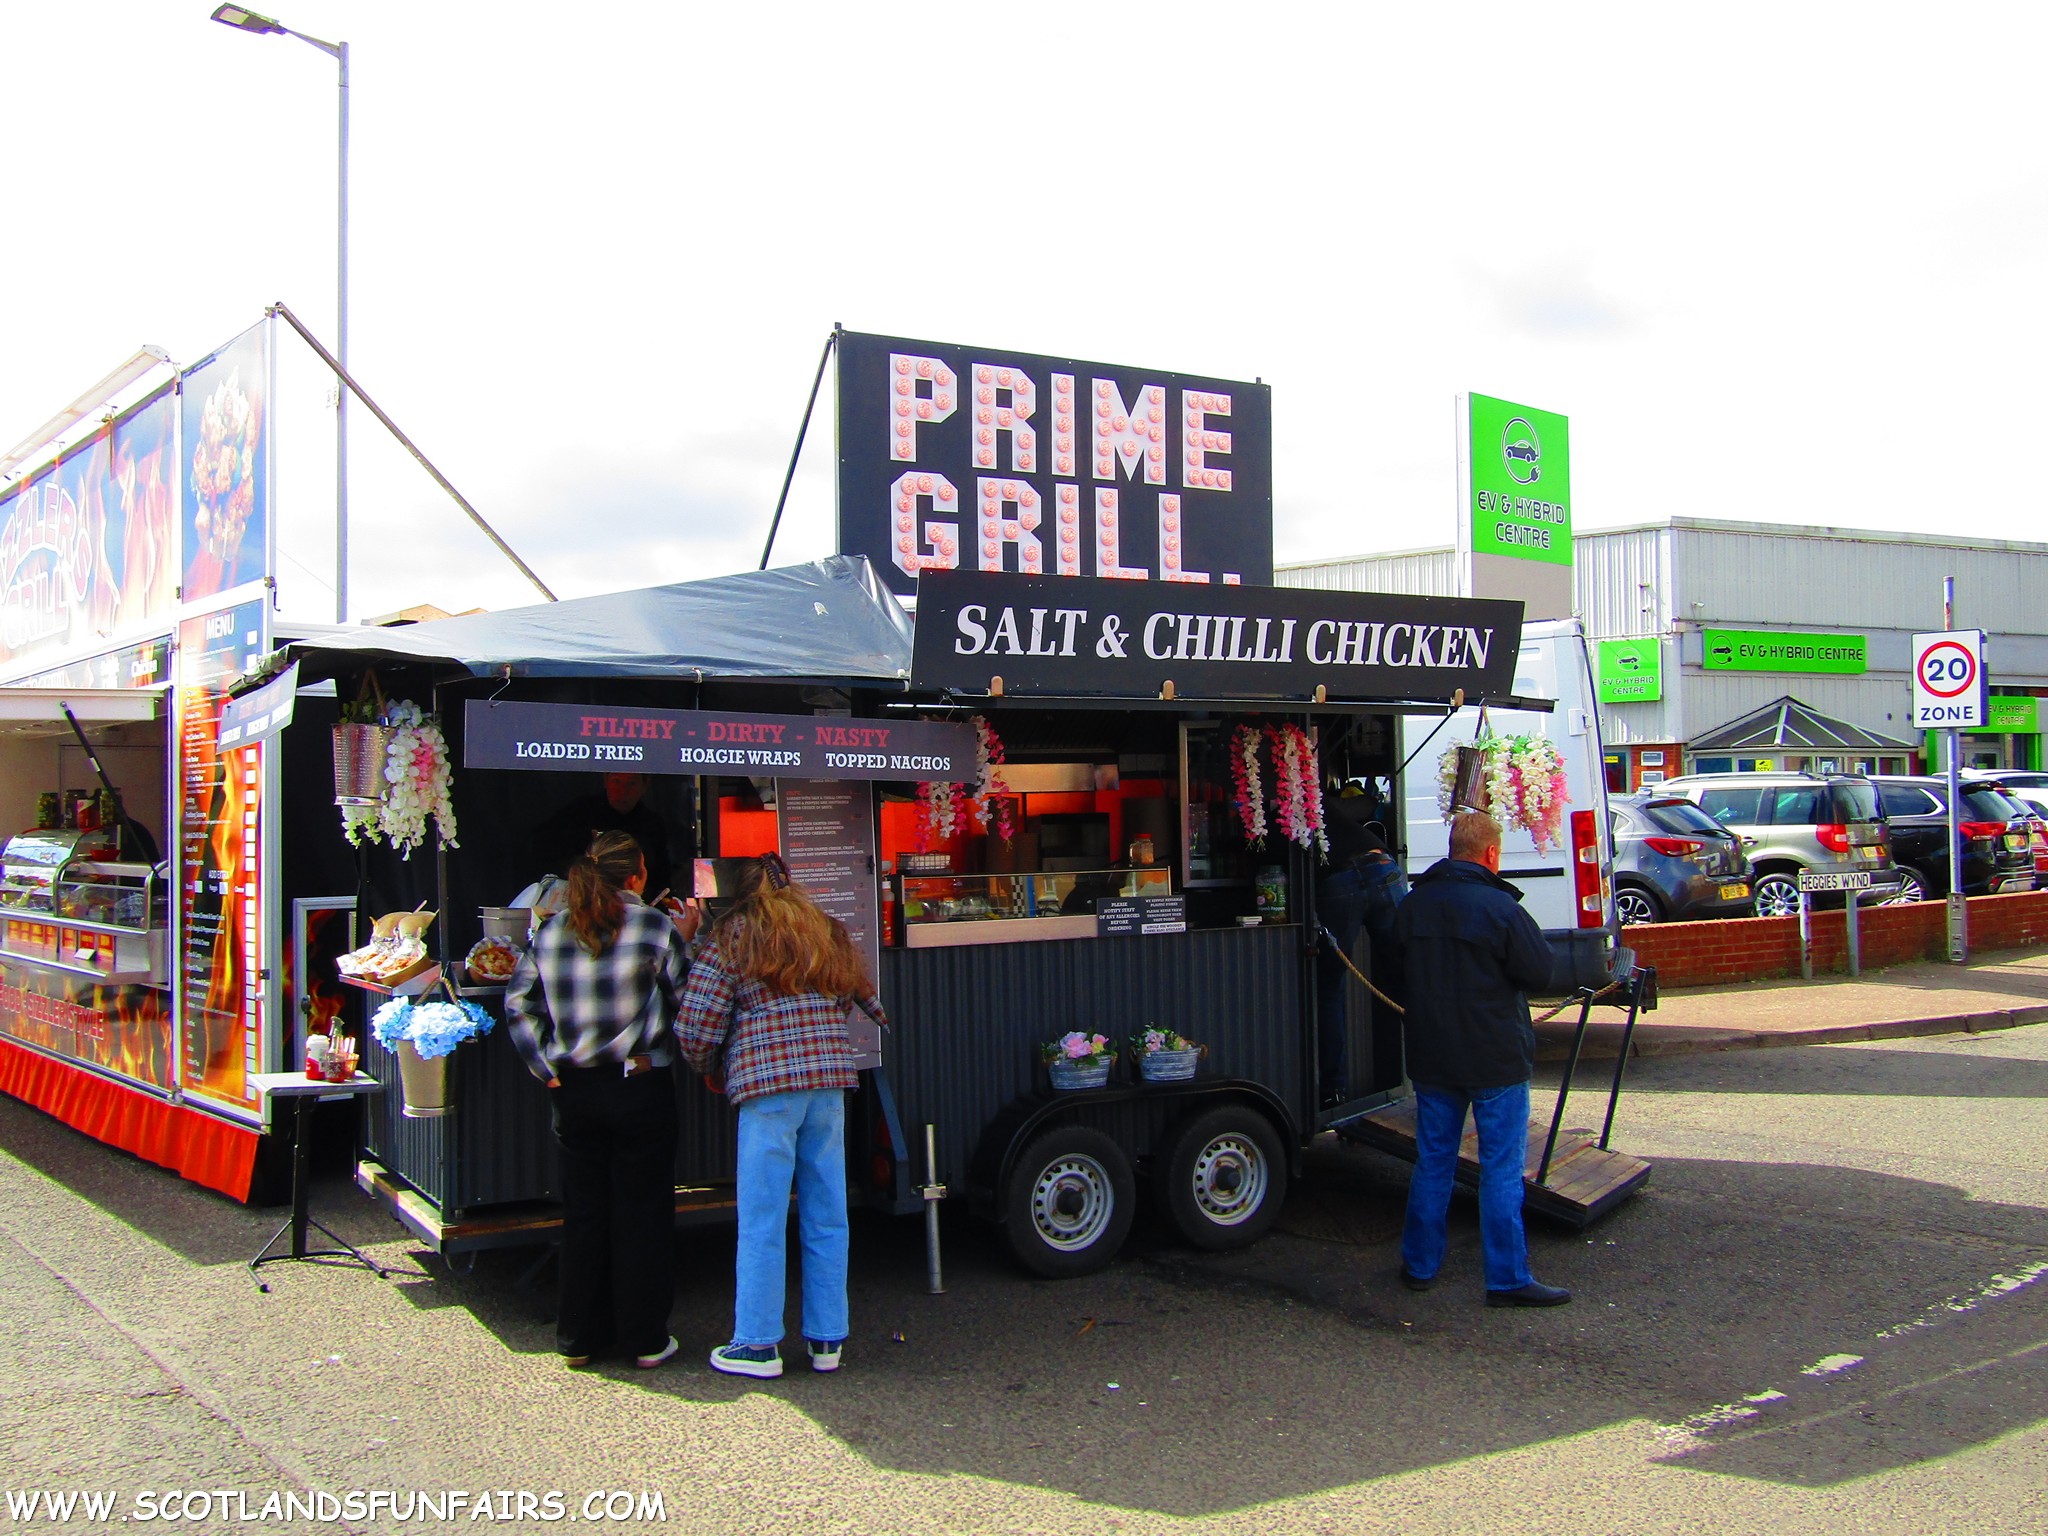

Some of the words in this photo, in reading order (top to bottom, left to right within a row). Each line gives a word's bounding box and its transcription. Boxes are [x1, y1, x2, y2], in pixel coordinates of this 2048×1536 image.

[890, 353, 1232, 492] PRIME
[1477, 491, 1497, 509] EV
[1500, 495, 1511, 514] &
[1514, 497, 1566, 525] HYBRID
[1495, 522, 1551, 550] CENTRE
[206, 613, 235, 640] MENU
[955, 604, 1087, 658] SALT
[1096, 614, 1129, 659] &
[1143, 612, 1297, 663] CHILLI
[1305, 618, 1493, 669] CHICKEN
[1740, 644, 1756, 657] EV
[1758, 645, 1767, 658] &
[1770, 646, 1815, 659] HYBRID
[1817, 647, 1864, 661] CENTRE
[1927, 658, 1968, 681] 20
[1602, 678, 1615, 686] EV
[1623, 676, 1655, 685] HYBRID
[1612, 686, 1646, 695] CENTRE
[1920, 706, 1974, 721] ZONE
[2006, 705, 2032, 713] HYBRID
[1997, 716, 2025, 725] CENTRE
[580, 716, 677, 740] FILTHY
[708, 721, 786, 744] DIRTY
[815, 726, 891, 748] NASTY
[516, 741, 591, 760] LOADED
[595, 744, 644, 761] FRIES
[680, 748, 746, 765] HOAGIE
[747, 750, 801, 766] WRAPS
[825, 753, 887, 770] TOPPED
[890, 754, 951, 771] NACHOS
[1800, 874, 1837, 891] HEGGIES
[1841, 872, 1869, 888] WYND
